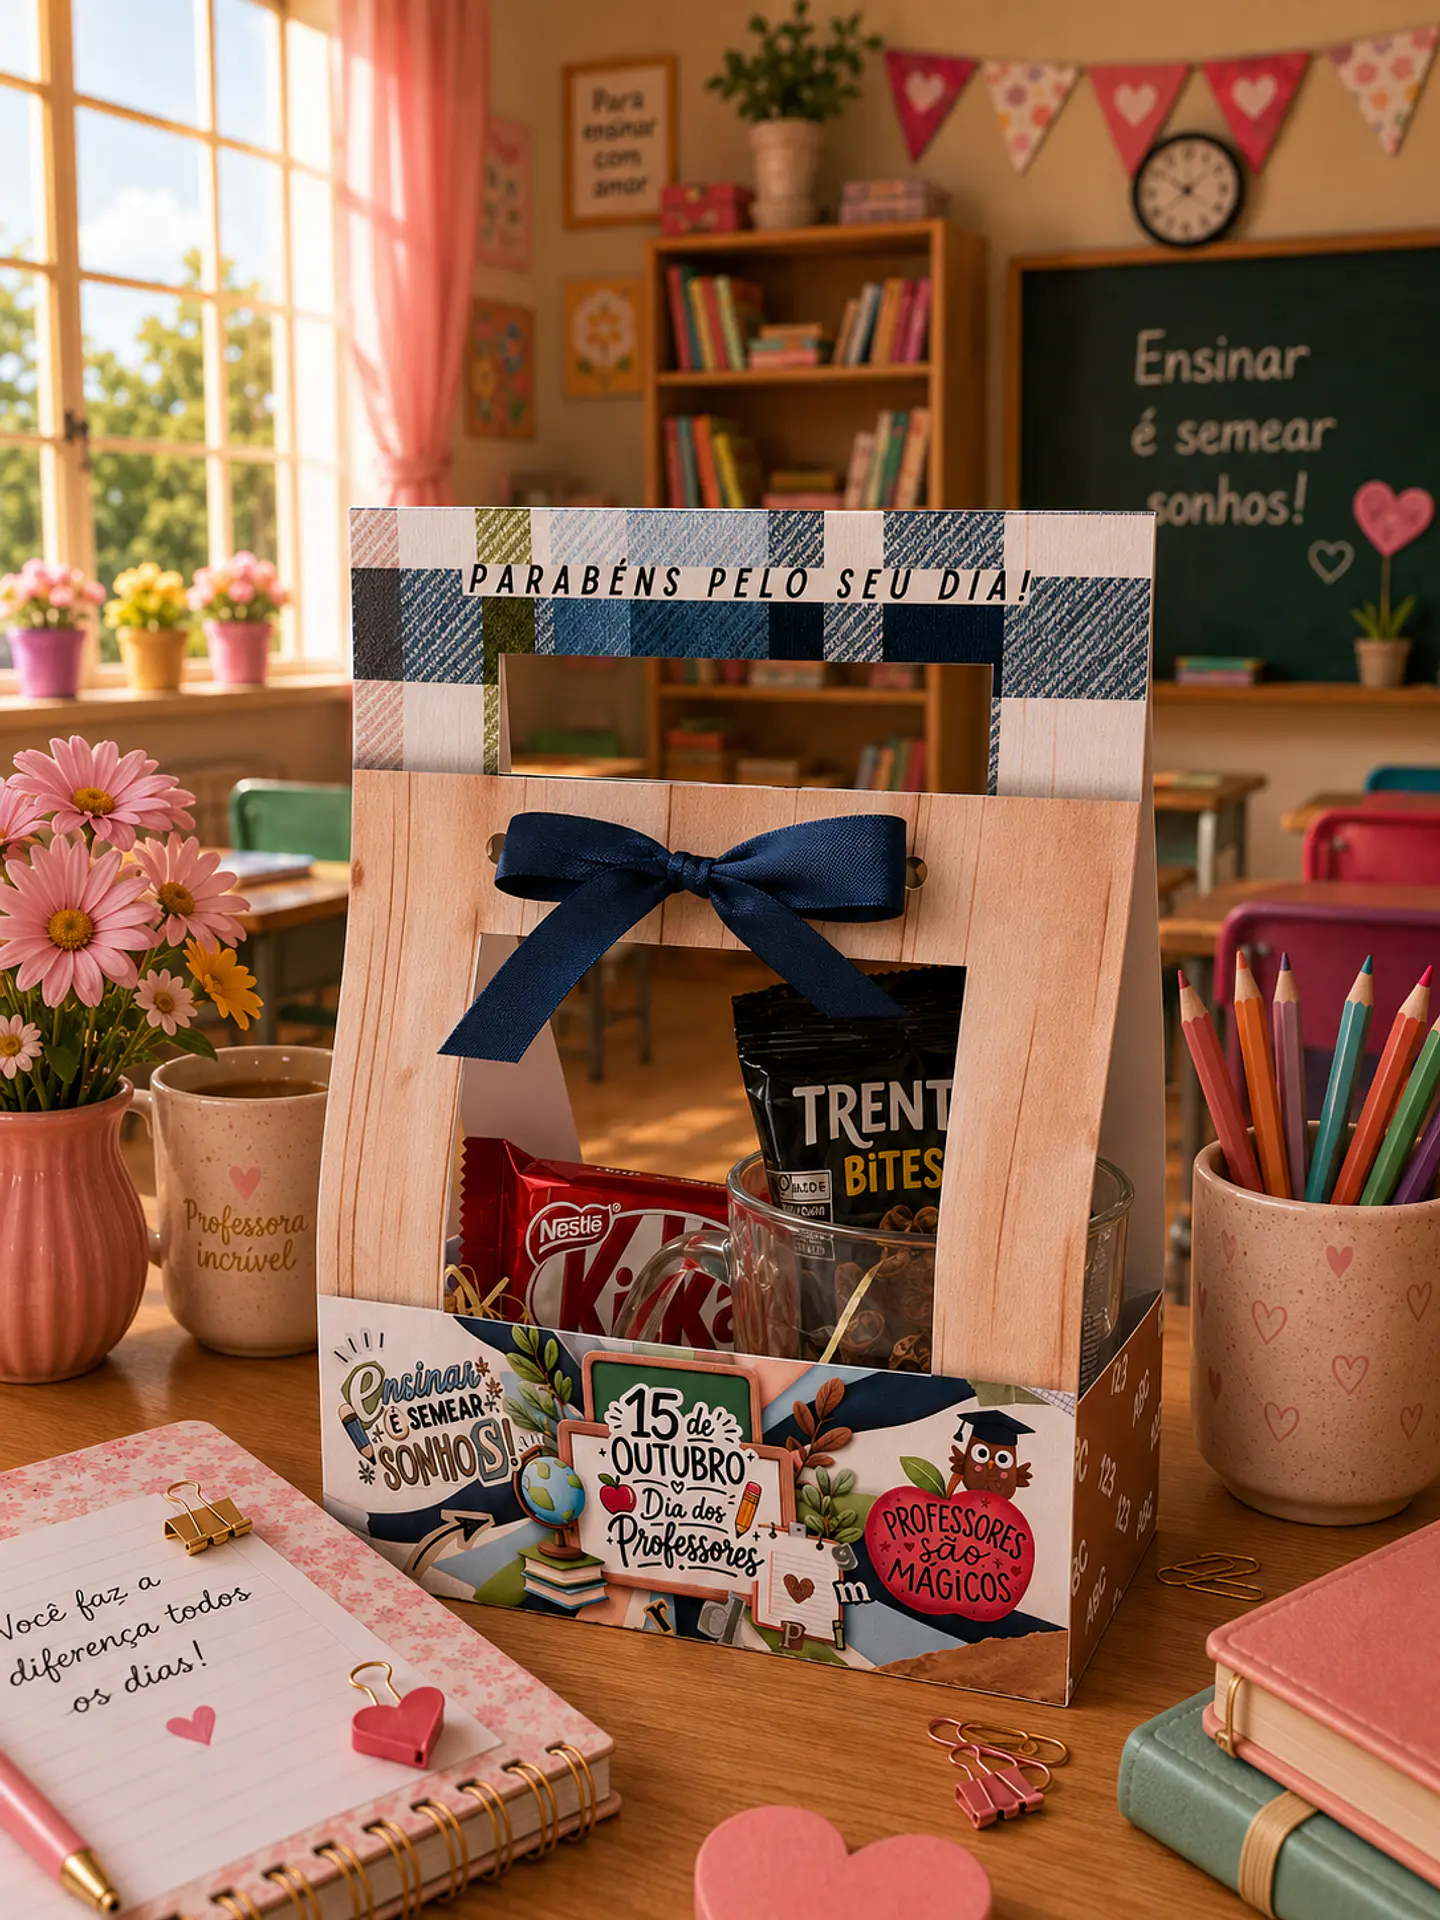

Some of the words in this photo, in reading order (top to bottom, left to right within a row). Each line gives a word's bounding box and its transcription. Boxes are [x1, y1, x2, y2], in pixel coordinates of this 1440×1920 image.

[591, 86, 644, 113] Para
[582, 118, 657, 142] ensinar
[592, 148, 642, 171] com
[593, 176, 649, 197] amor
[1135, 328, 1311, 385] Ensinar
[1131, 406, 1157, 457] é
[1174, 417, 1337, 455] semear
[1147, 469, 1308, 526] sonhos!
[469, 557, 681, 596] PARABÉNS
[707, 567, 808, 598] PELO
[837, 568, 912, 599] SEU
[937, 570, 1031, 601] DIA!
[183, 1198, 309, 1245] Professora
[197, 1238, 297, 1273] incrível
[1111, 1353, 1128, 1396] 123
[407, 1393, 486, 1430] SEMEAR
[625, 1388, 679, 1441] 15
[687, 1406, 715, 1437] de
[379, 1417, 520, 1491] SONHOS!
[611, 1436, 745, 1485] OUTUBRO
[1098, 1453, 1117, 1498] 123
[641, 1487, 687, 1520] Dia
[692, 1496, 727, 1524] dos
[1115, 1494, 1131, 1533] 123
[608, 1514, 765, 1577] Professores
[882, 1503, 1027, 1560] PROFESSORES
[919, 1535, 991, 1566] são
[0, 1603, 67, 1640] Você
[75, 1589, 128, 1621] faz
[138, 1576, 161, 1590] a
[835, 1581, 872, 1604] m
[1085, 1566, 1107, 1635] ABC
[10, 1622, 160, 1686] diferença
[164, 1589, 252, 1624] todos
[70, 1688, 112, 1714] os
[124, 1640, 207, 1693] dias!
